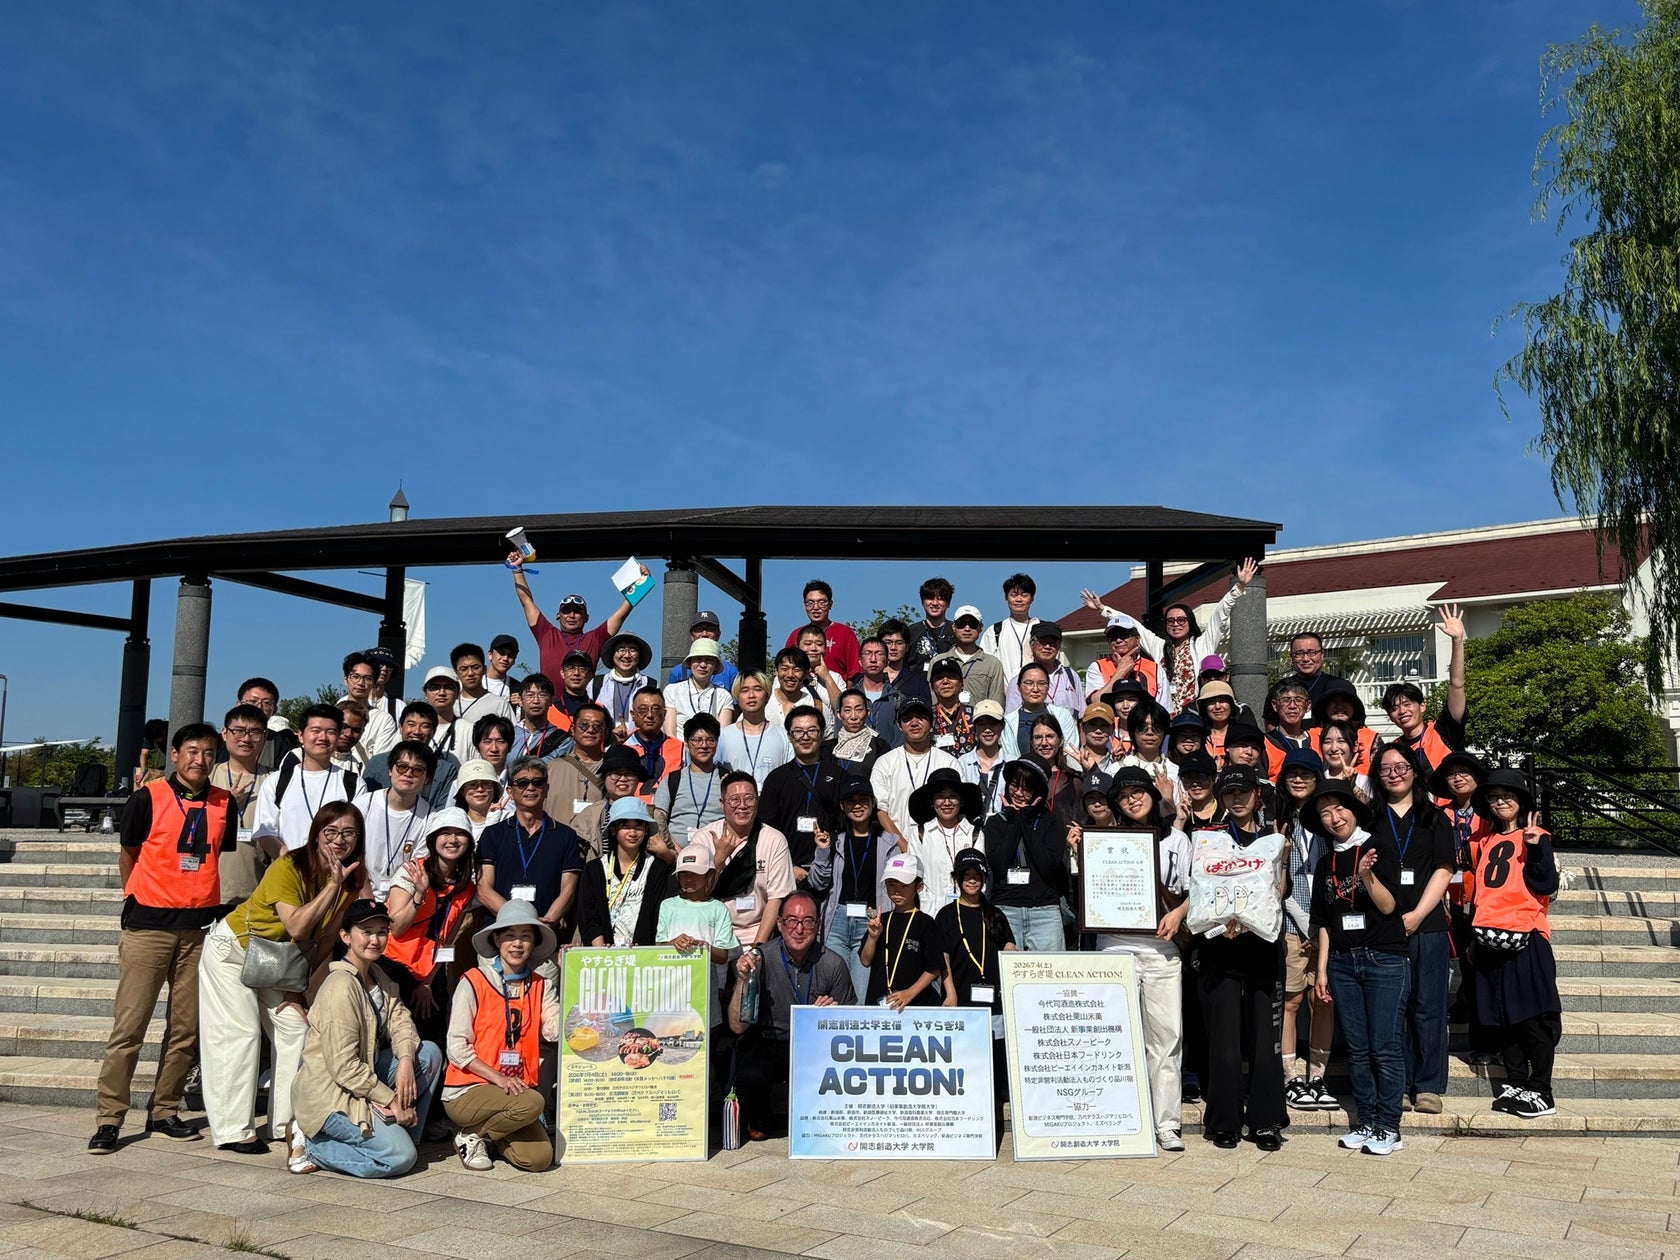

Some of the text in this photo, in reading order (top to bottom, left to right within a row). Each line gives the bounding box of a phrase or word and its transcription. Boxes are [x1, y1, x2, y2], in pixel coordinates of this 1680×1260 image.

[176, 807, 211, 864] 4
[1484, 840, 1515, 888] 8
[581, 954, 637, 968] やすらぎ堤
[1012, 970, 1054, 979] やすらぎ堤
[1086, 970, 1123, 979] ACTION!
[579, 964, 692, 1014] CLEAN ACTION!
[817, 1020, 965, 1031] 開志創造大学主催 やすらぎ堤
[830, 1035, 952, 1063] CLEAN
[818, 1067, 965, 1096] ACTION!
[1056, 1088, 1104, 1097] NSGグループ
[911, 1142, 935, 1151] 大学院
